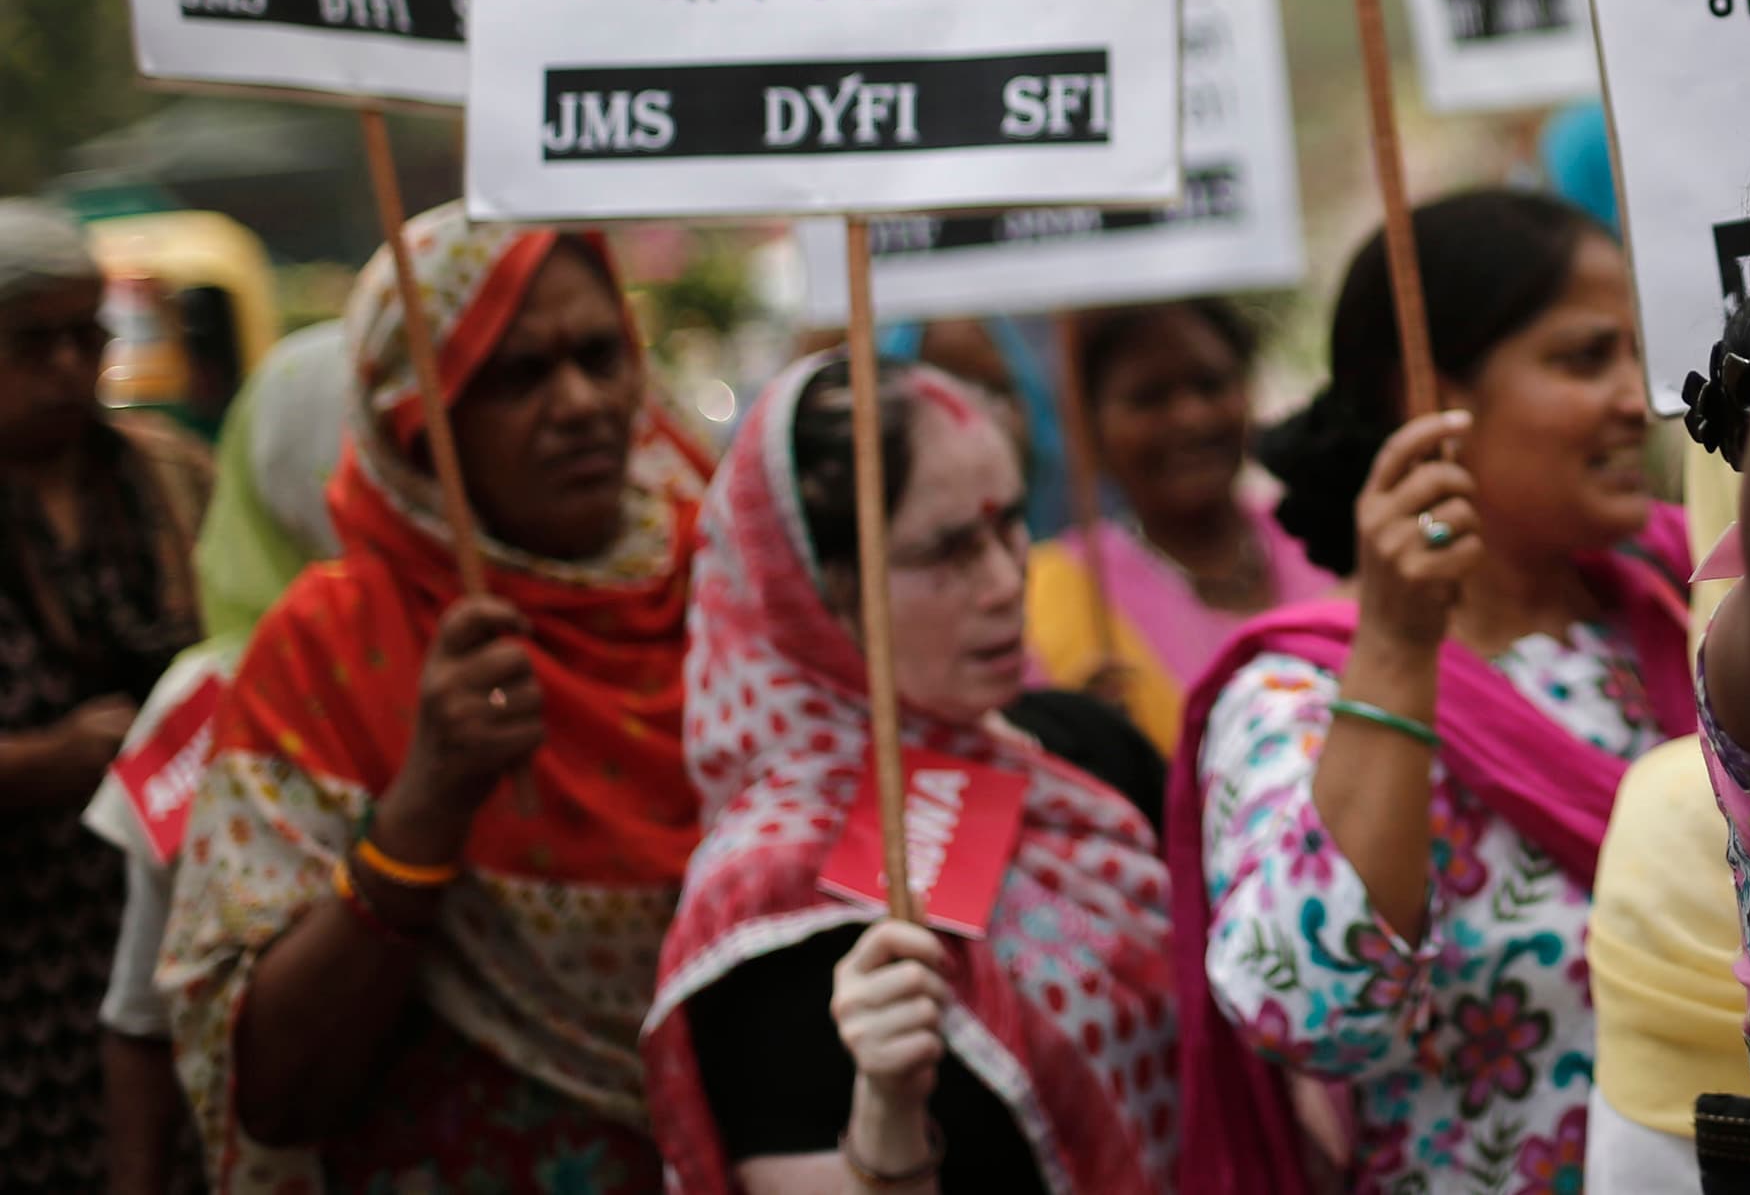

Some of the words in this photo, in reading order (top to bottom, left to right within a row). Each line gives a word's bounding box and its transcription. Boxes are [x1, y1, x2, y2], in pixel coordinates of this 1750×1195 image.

[544, 89, 676, 153] JMS
[762, 72, 922, 149] DYFI
[1001, 72, 1110, 139] SFI
